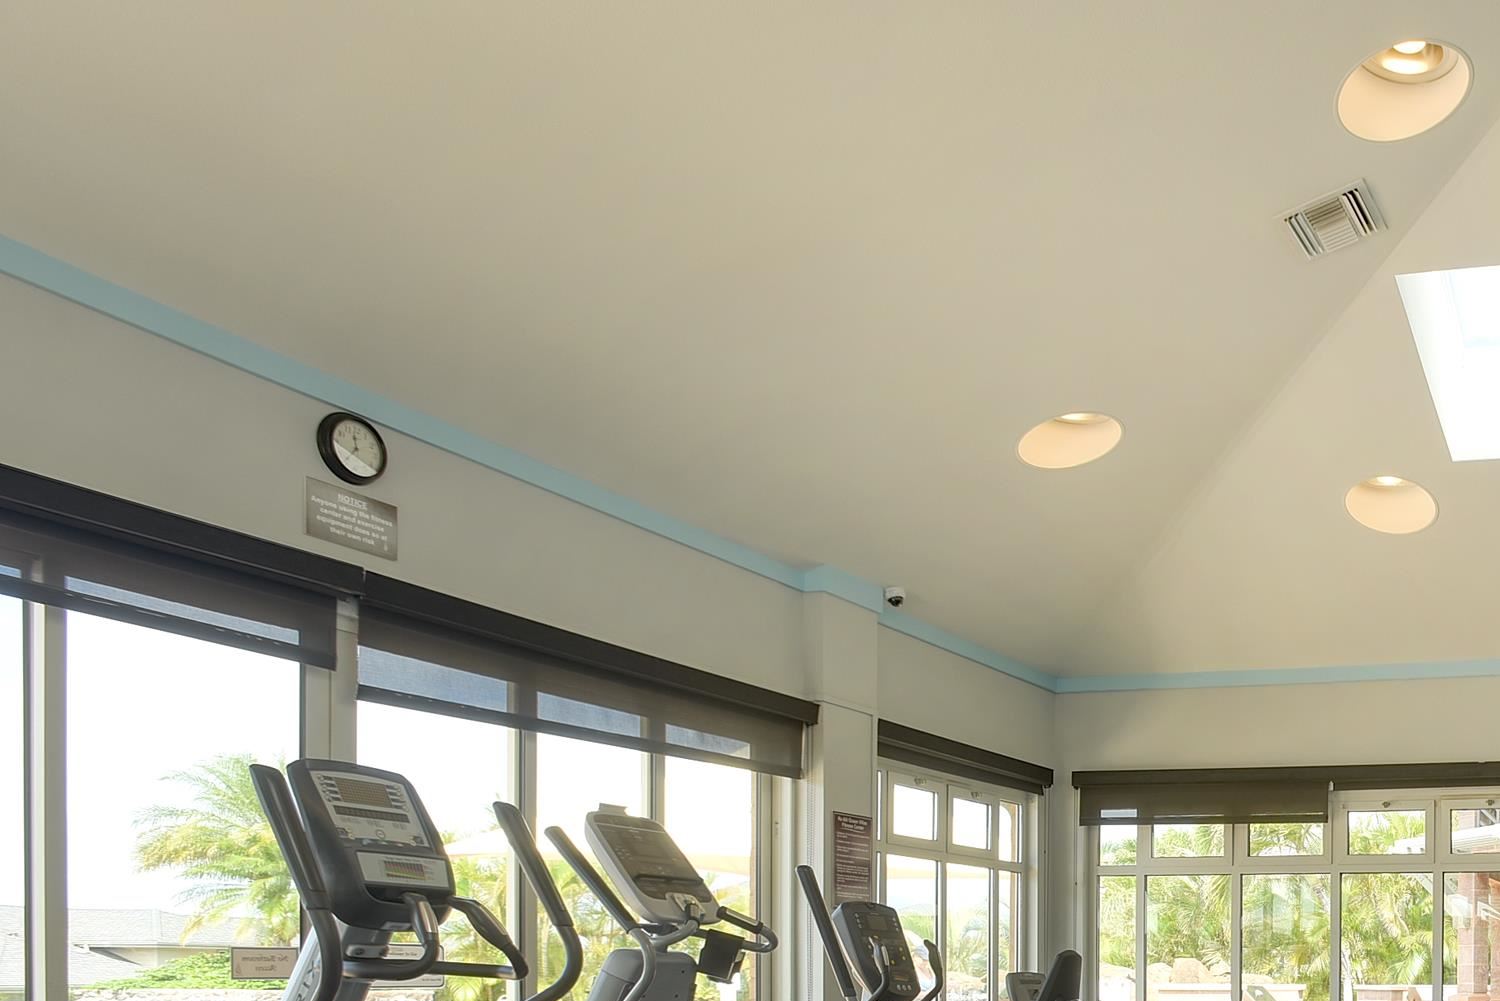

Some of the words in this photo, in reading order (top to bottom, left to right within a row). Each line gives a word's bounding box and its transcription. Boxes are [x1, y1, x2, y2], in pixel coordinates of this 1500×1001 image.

[311, 495, 338, 508] Anyone
[359, 511, 370, 520] the
[371, 514, 393, 527] fitness
[337, 494, 368, 510] NOTICE
[316, 514, 353, 530] equipment
[353, 526, 370, 536] does
[320, 507, 342, 519] center
[342, 514, 356, 523] and
[357, 519, 385, 532] exercise
[362, 537, 375, 545] risk
